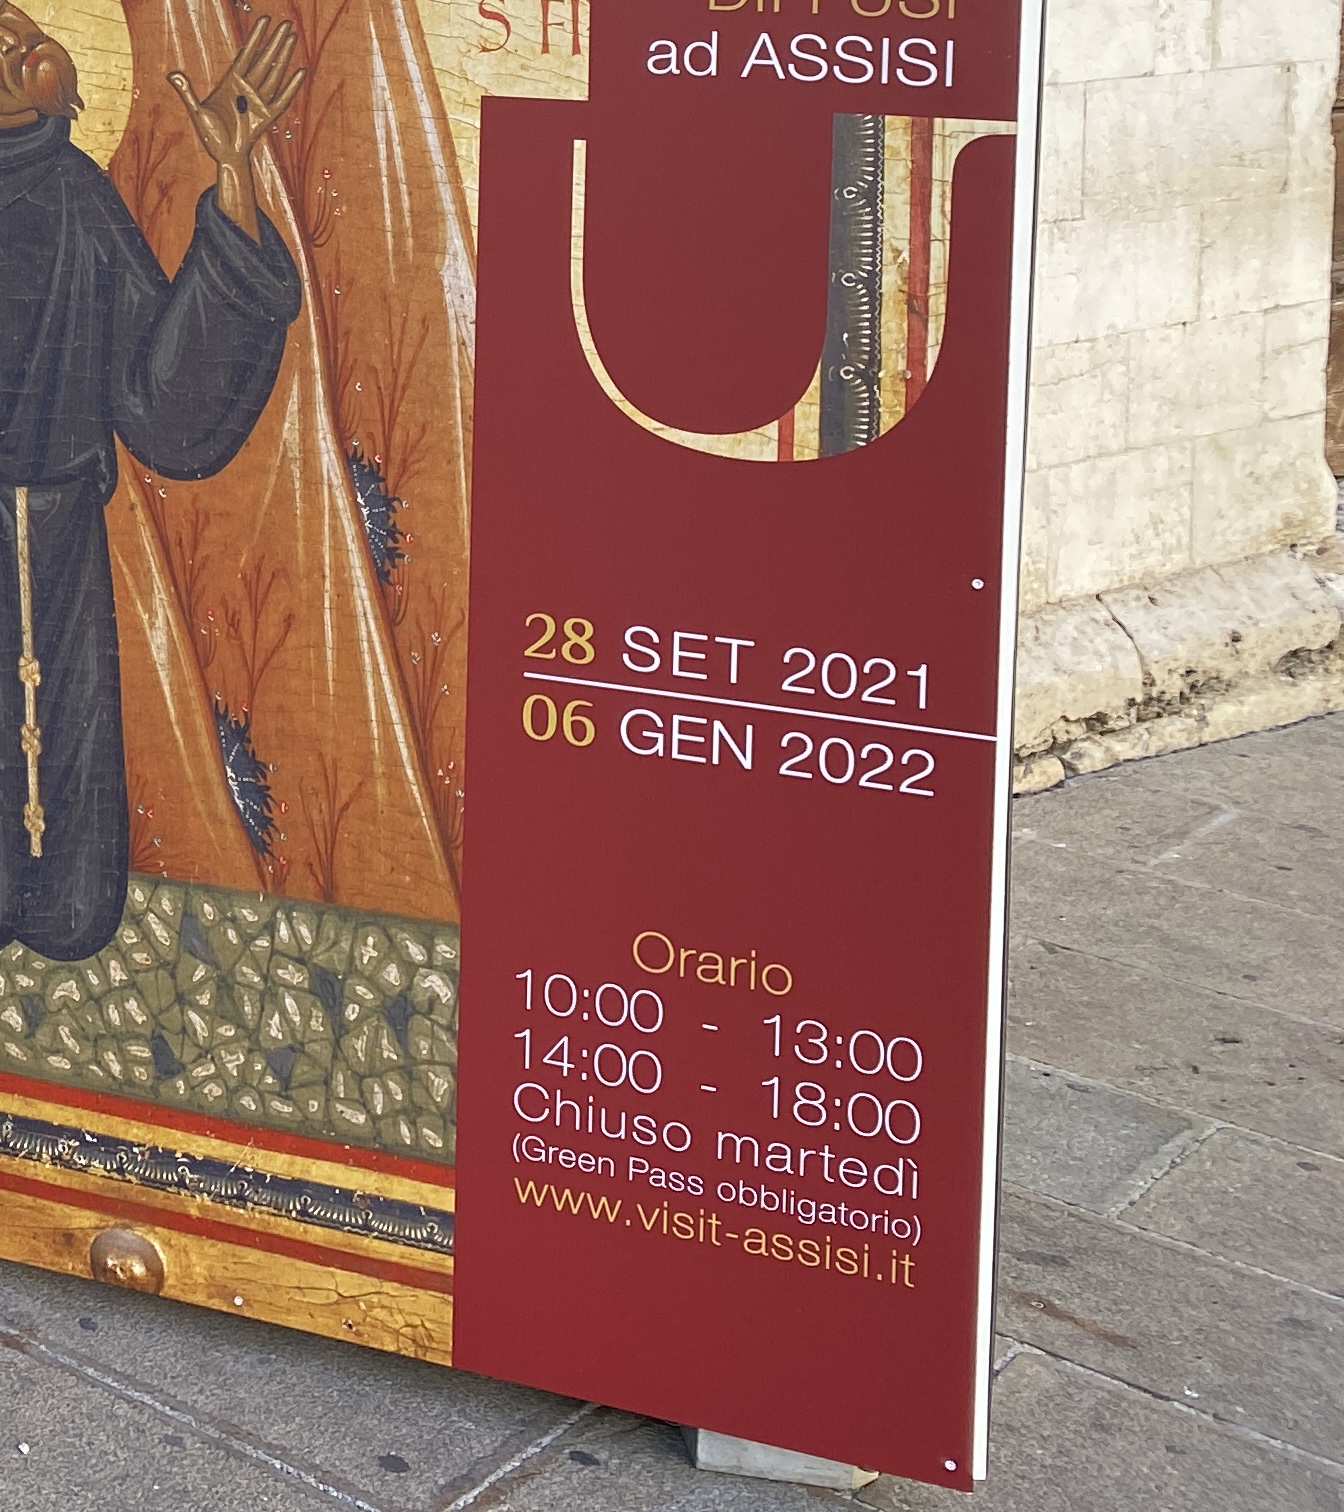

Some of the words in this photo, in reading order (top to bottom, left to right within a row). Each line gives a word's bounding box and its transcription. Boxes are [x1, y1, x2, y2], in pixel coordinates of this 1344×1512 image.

[646, 31, 719, 76] ad
[740, 32, 955, 88] ASSISI
[522, 613, 596, 666] 28
[621, 625, 755, 685] SET
[780, 647, 930, 710] 2021
[521, 694, 596, 747] 06
[619, 708, 754, 771] GEN
[778, 731, 935, 797] 2022
[632, 930, 793, 996] Orario
[514, 968, 665, 1034] 10:00
[762, 1014, 923, 1082] 13:00
[512, 1081, 692, 1152] Chiuso
[715, 1128, 921, 1200] martedì
[513, 1028, 663, 1094] 14:00
[761, 1076, 922, 1145] 18:00
[512, 1133, 616, 1178] (Green
[627, 1158, 705, 1196] Pass
[716, 1178, 923, 1246] obbligatorio)
[513, 1176, 917, 1288] www.visit-assisi.it
